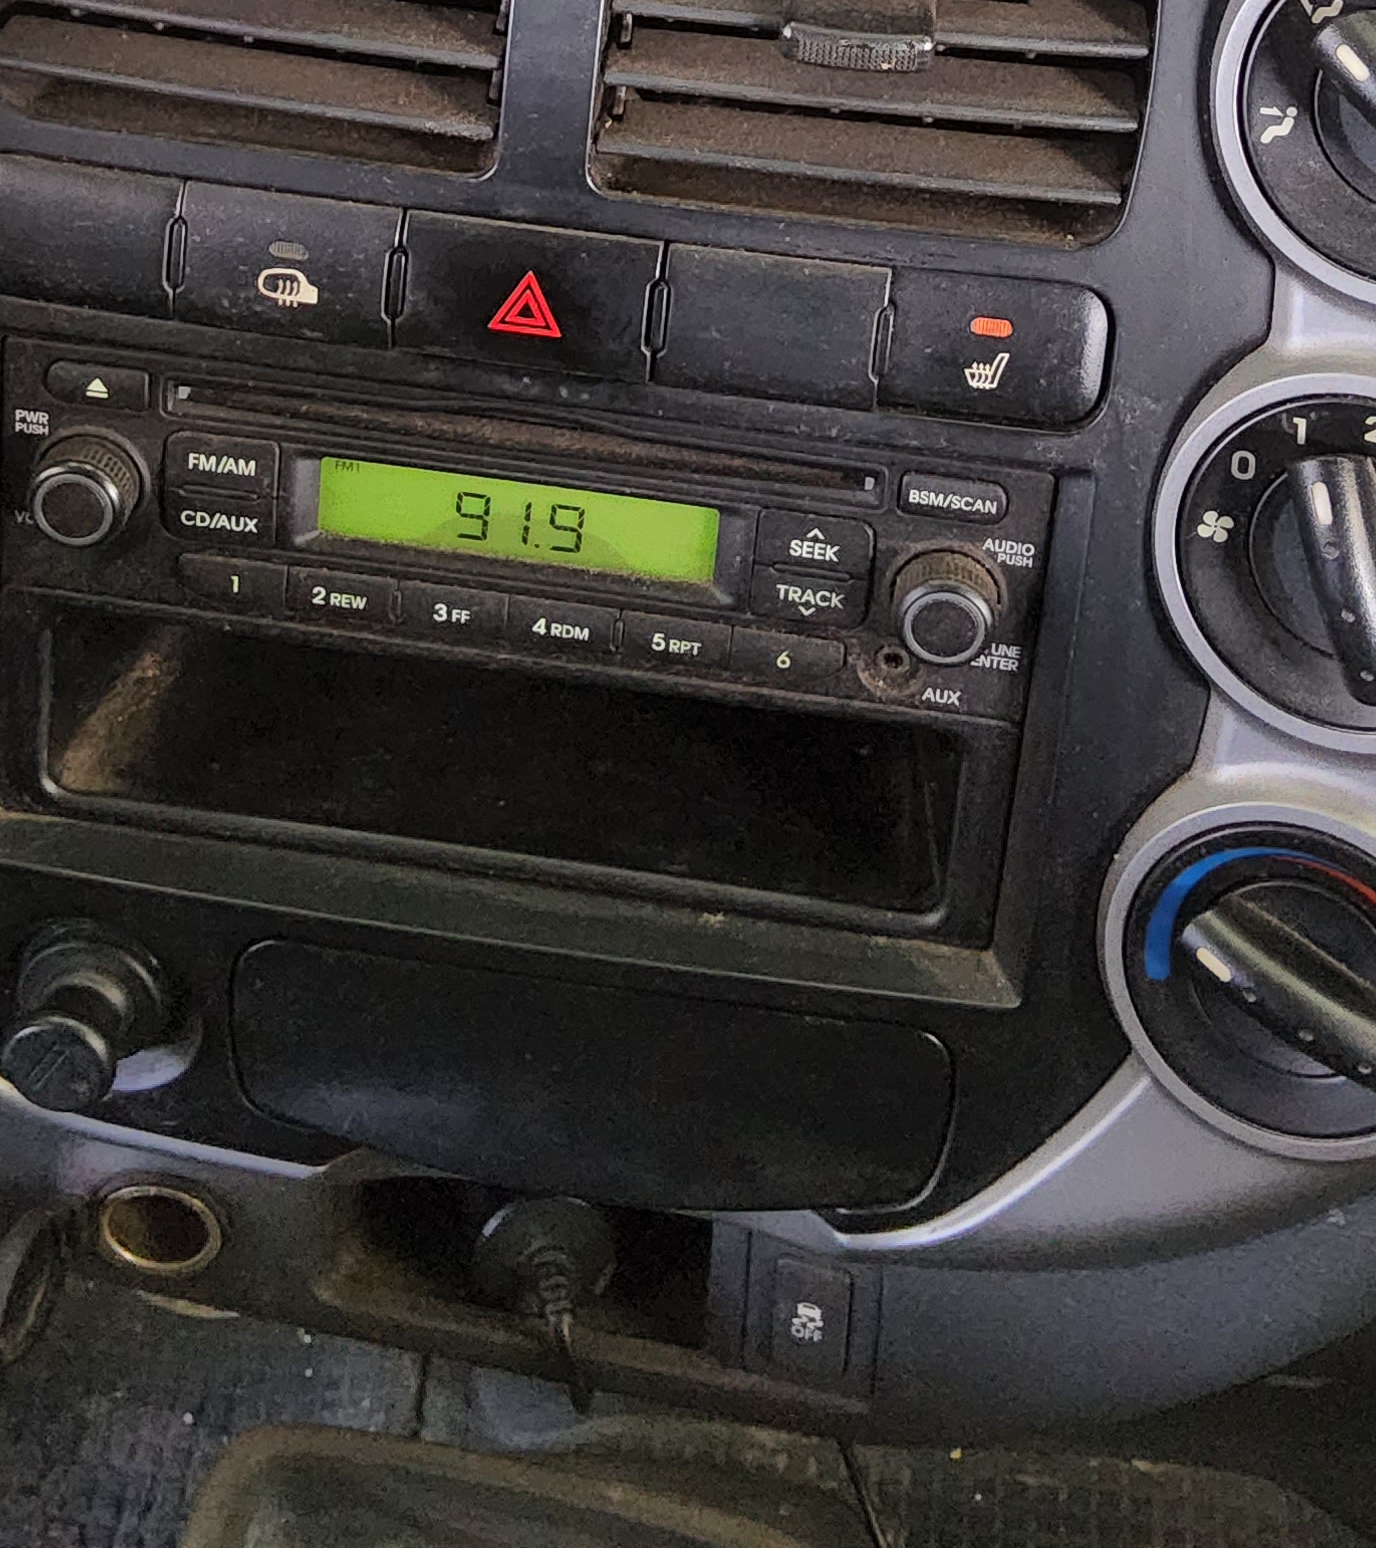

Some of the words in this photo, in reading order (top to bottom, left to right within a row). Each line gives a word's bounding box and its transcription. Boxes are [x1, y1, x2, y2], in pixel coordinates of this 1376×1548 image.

[14, 408, 50, 425] PWR
[14, 422, 50, 437] PUSH
[1292, 415, 1307, 446] 1
[187, 453, 257, 477] FM/AM
[1230, 449, 1257, 481] 0
[908, 488, 999, 515] BSM/SCAN
[180, 510, 259, 534] CD/AUX
[455, 491, 586, 554] 91.9
[789, 538, 840, 563] SEEK
[982, 537, 1036, 557] AUDIO
[997, 553, 1034, 568] PUSH
[229, 575, 241, 595] 1
[776, 584, 845, 610] TRACK
[311, 586, 327, 606] 2
[329, 592, 368, 611] REW
[433, 602, 449, 624] 3
[451, 608, 471, 625] FF
[532, 617, 547, 637] 4
[550, 623, 590, 642] RDM
[651, 632, 666, 653] 5
[668, 638, 702, 657] RPT
[984, 643, 1022, 659] UNE
[776, 650, 792, 671] 6
[921, 686, 962, 708] AUX
[790, 1325, 823, 1342] OFF
